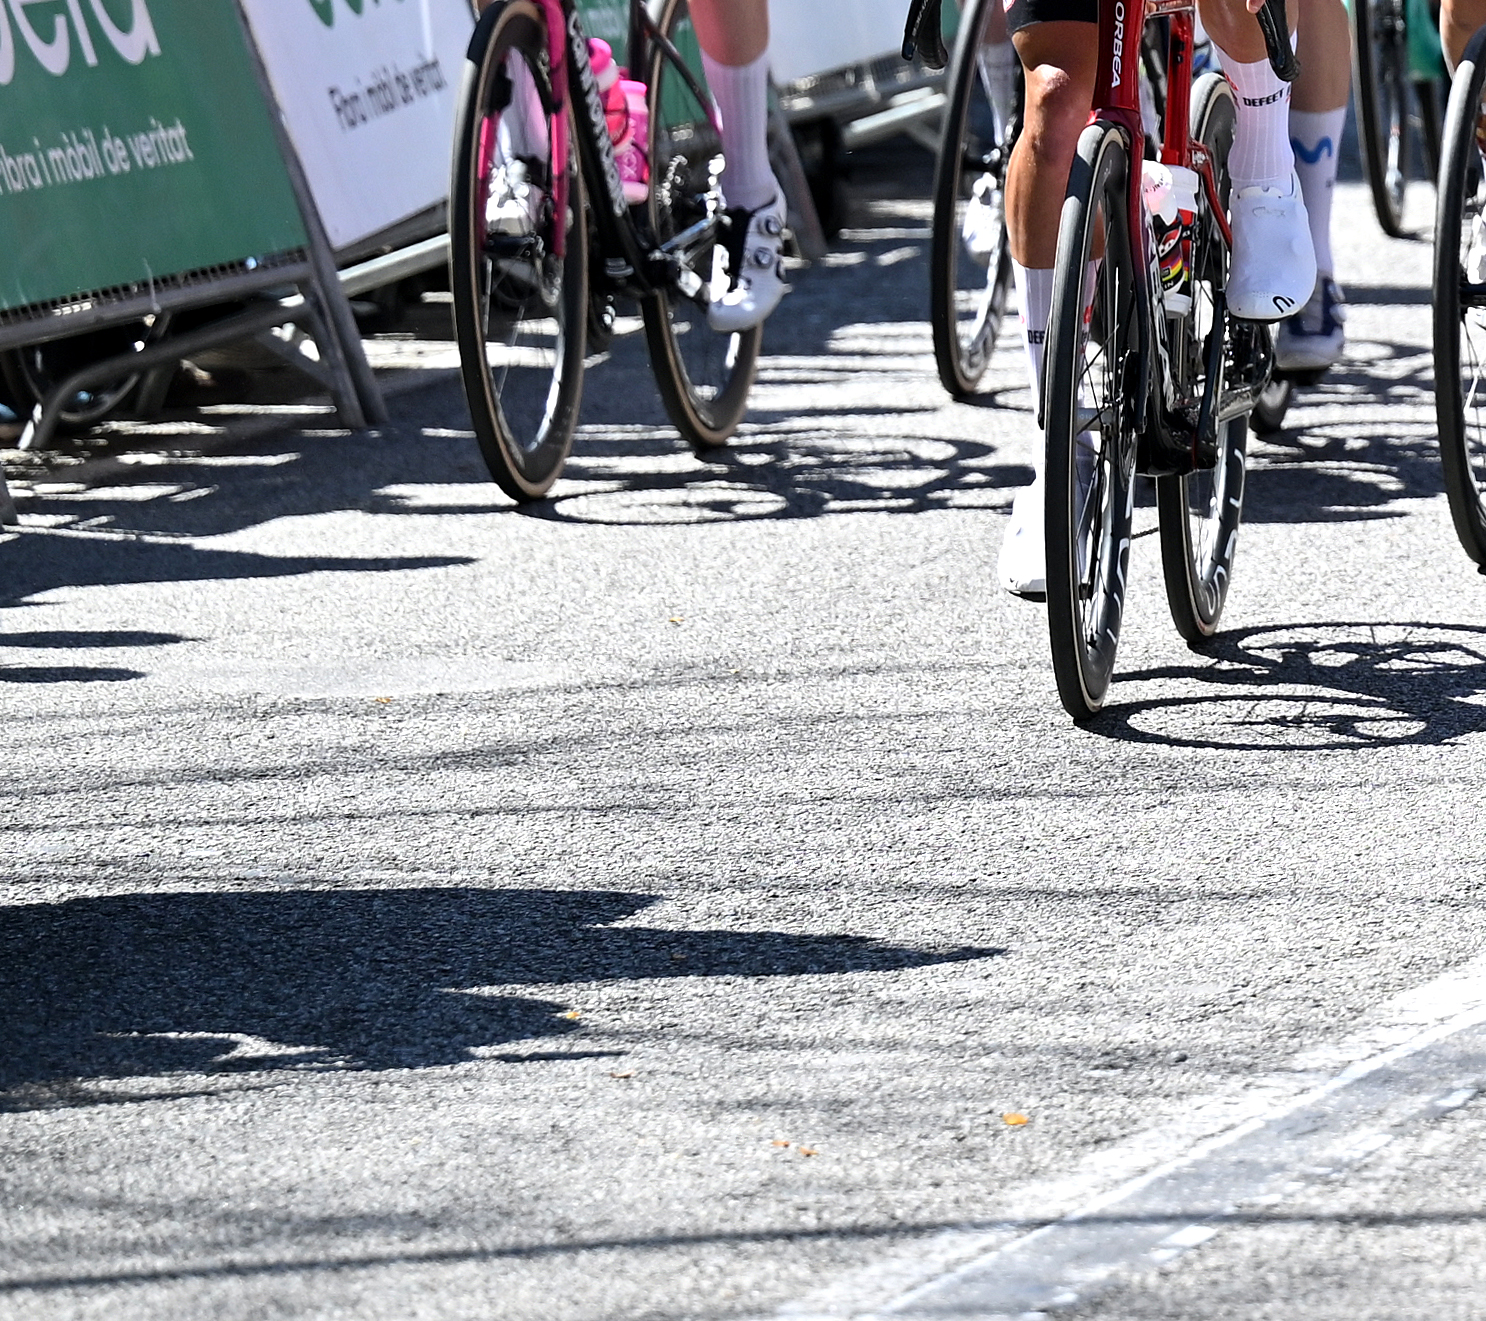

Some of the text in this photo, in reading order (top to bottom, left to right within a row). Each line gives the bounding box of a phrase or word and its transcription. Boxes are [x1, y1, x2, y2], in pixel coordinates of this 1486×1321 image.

[1111, 1, 1125, 88] ORBEA
[1243, 91, 1283, 107] DEFEET
[102, 125, 130, 174] de
[127, 117, 194, 169] veritat
